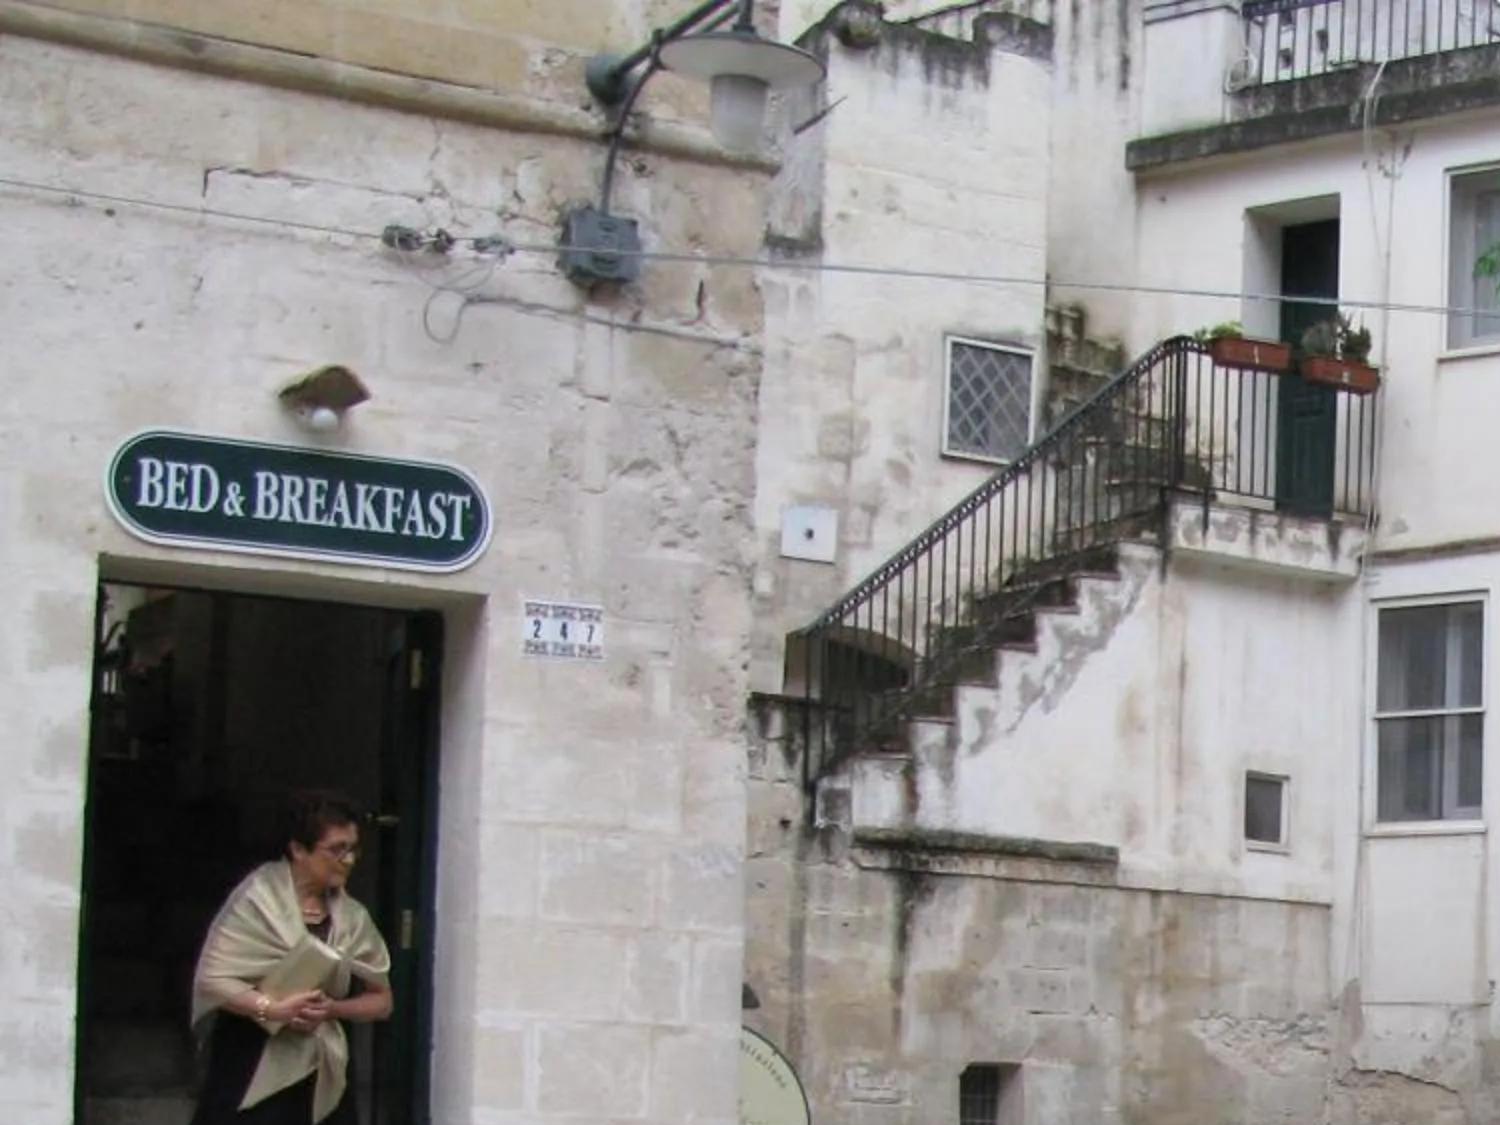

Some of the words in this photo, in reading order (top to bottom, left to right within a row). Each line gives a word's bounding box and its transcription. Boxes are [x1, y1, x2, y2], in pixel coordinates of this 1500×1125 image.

[136, 457, 220, 513] BED
[222, 481, 246, 517] &
[252, 471, 471, 541] BREAKFAST
